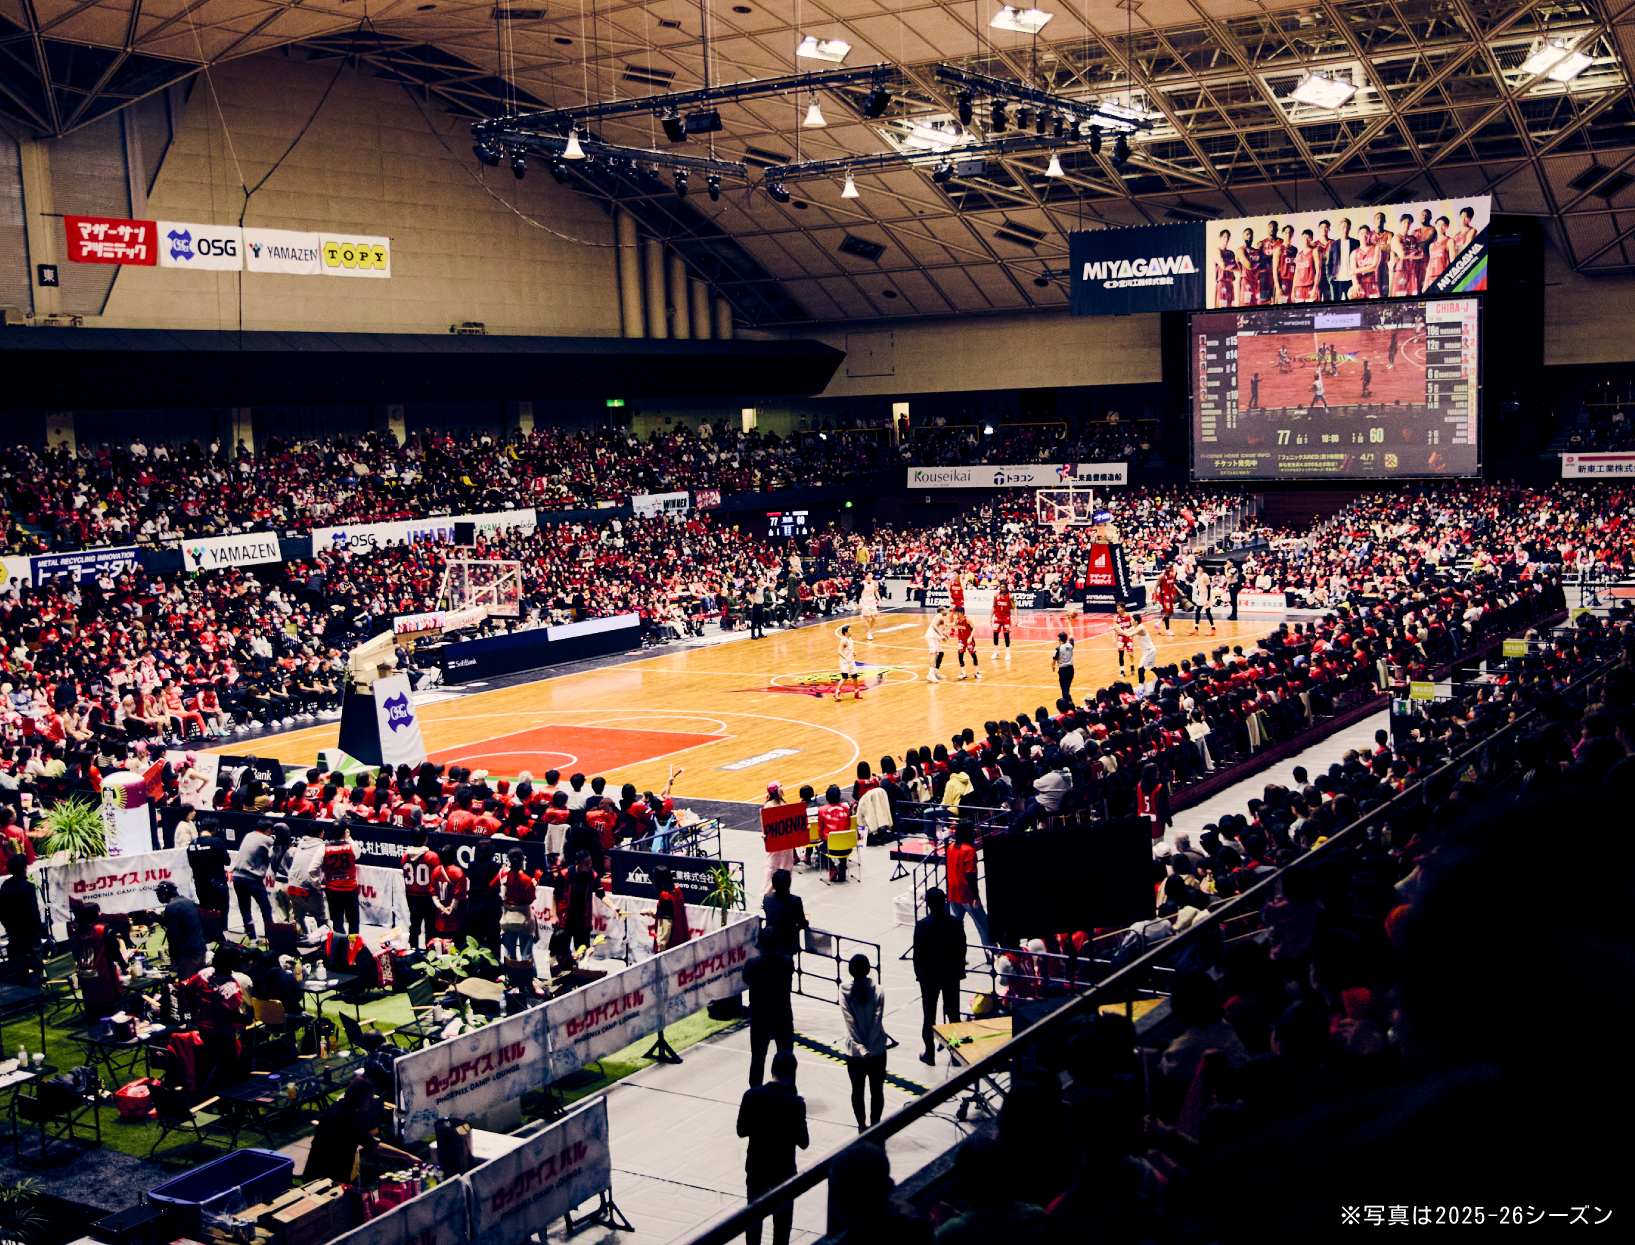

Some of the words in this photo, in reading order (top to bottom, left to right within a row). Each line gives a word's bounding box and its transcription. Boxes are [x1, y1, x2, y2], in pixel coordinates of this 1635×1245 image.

[78, 222, 146, 243] マザーサン
[79, 241, 147, 260] アツミテック
[197, 238, 237, 257] OSG
[267, 246, 318, 262] YAMAZEN
[328, 249, 384, 262] TOPY
[43, 269, 55, 282] 東
[1082, 254, 1195, 281] MIYAGAWA
[1437, 243, 1484, 291] MIYAGAWA
[1436, 302, 1469, 315] CHIBA-J
[1277, 429, 1291, 445] 77
[1369, 427, 1384, 443] 60
[1360, 453, 1375, 461] 4/1
[914, 469, 971, 483] Kouseikai
[1071, 473, 1123, 482] 来島豊橋造船
[1578, 463, 1635, 474] 新東工業株式
[1007, 474, 1034, 483] トヨコン
[351, 533, 376, 547] OSG
[38, 559, 59, 567] METAL
[60, 555, 96, 566] RECYCLING
[97, 551, 135, 561] INNOVATION
[210, 543, 277, 563] YAMAZEN
[455, 658, 478, 668] SoftBank
[765, 814, 807, 839] PHOENIX
[328, 852, 351, 871] 28
[73, 871, 141, 893] ロックアイス
[402, 862, 430, 886] 30
[83, 891, 114, 901] PHOENIX
[117, 888, 137, 896] CAMP
[677, 953, 725, 988] ロックアイス
[684, 981, 706, 995] PHOENIX
[706, 974, 723, 985] CAMP
[566, 998, 620, 1038] ロックアイス
[574, 1029, 602, 1045] PHOENIX
[602, 1020, 618, 1034] CAMP
[619, 1010, 641, 1026] LOUNGE
[425, 1052, 494, 1097] ロックアイス
[436, 1086, 469, 1106] PHOENIX
[469, 1076, 491, 1092] CAMP
[492, 1063, 521, 1082] LOUNGE
[491, 1154, 558, 1213] ロックアイス
[501, 1197, 532, 1222] PHOENIX
[533, 1184, 555, 1201] CAMP
[556, 1165, 583, 1189] LOUNGE
